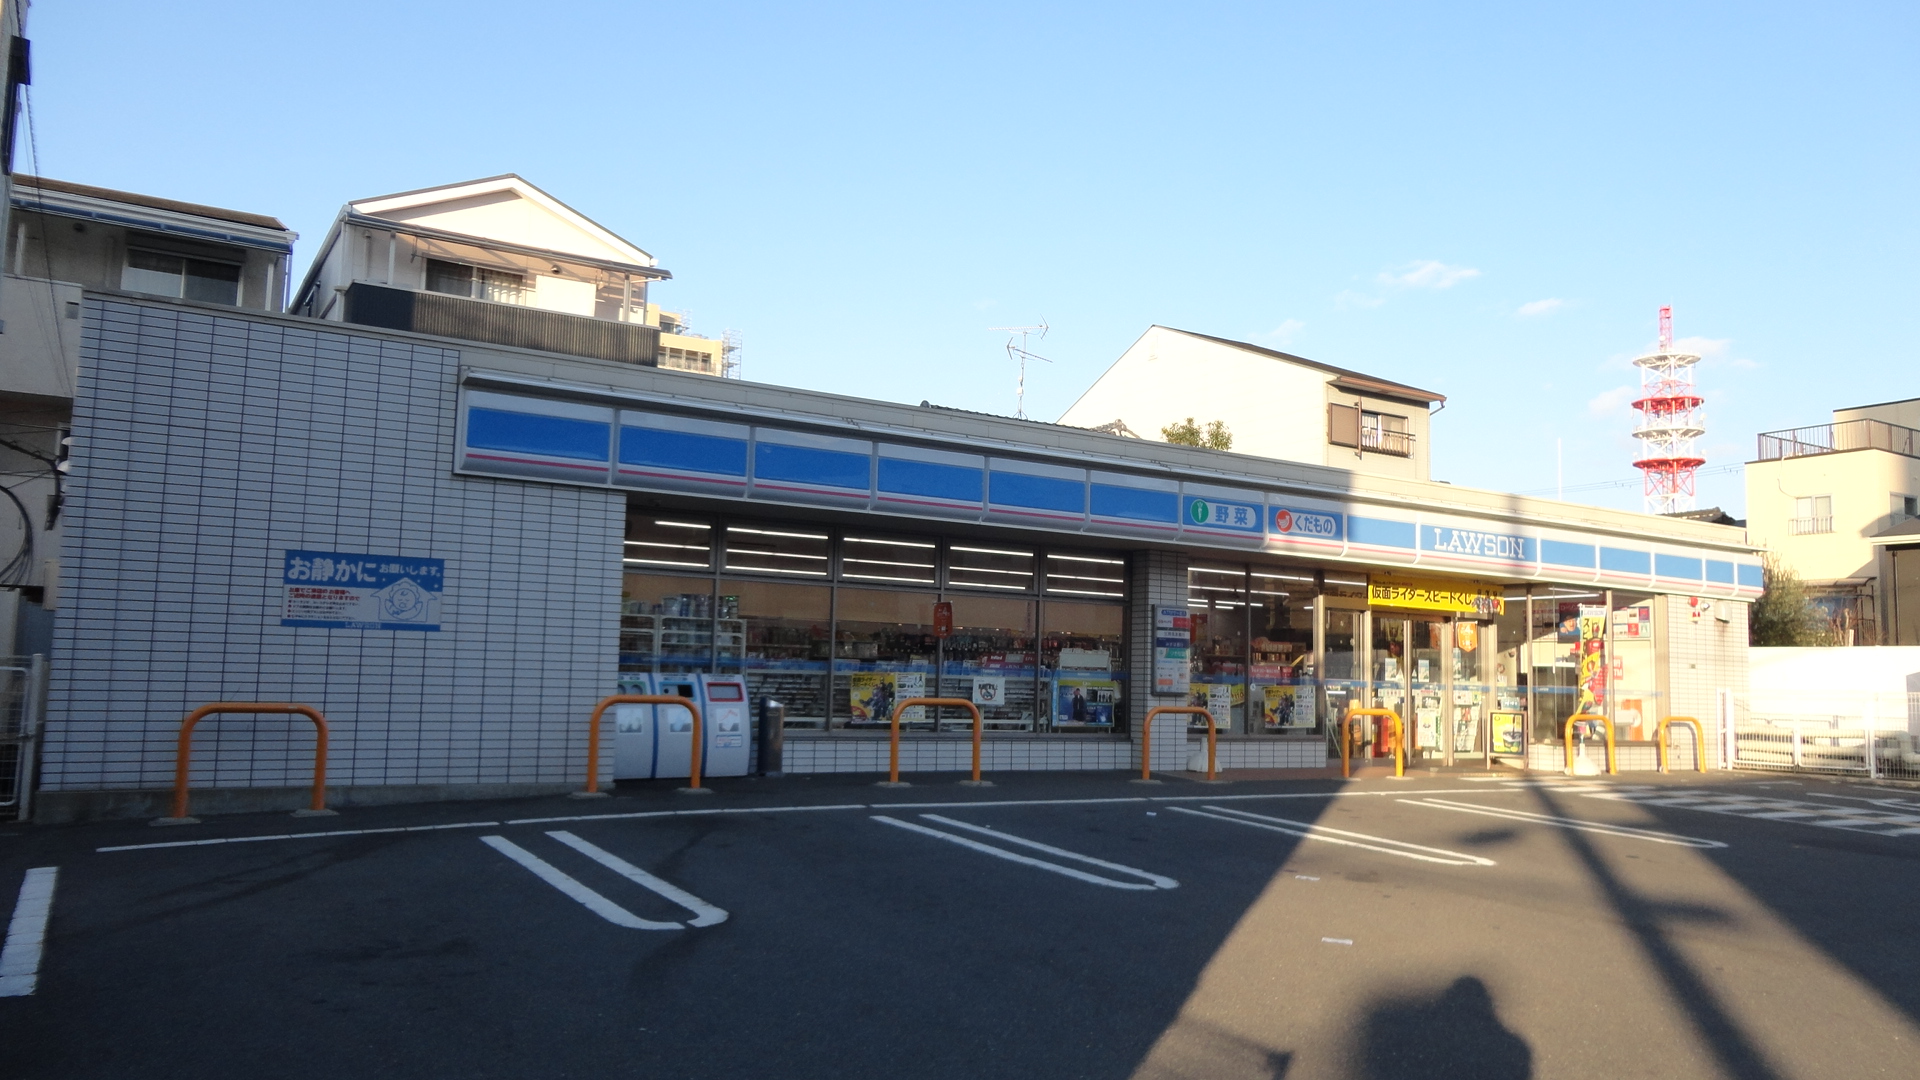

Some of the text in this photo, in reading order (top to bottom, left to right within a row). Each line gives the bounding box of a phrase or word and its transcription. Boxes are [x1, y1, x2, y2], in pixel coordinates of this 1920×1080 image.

[1215, 505, 1248, 526] 野菜
[1295, 515, 1333, 534] くだもの
[1434, 528, 1525, 559] LAWSON
[288, 557, 376, 582] お静かに
[1372, 586, 1472, 605] 仮面ライダースピードくじ
[345, 621, 382, 630] LAWSON
